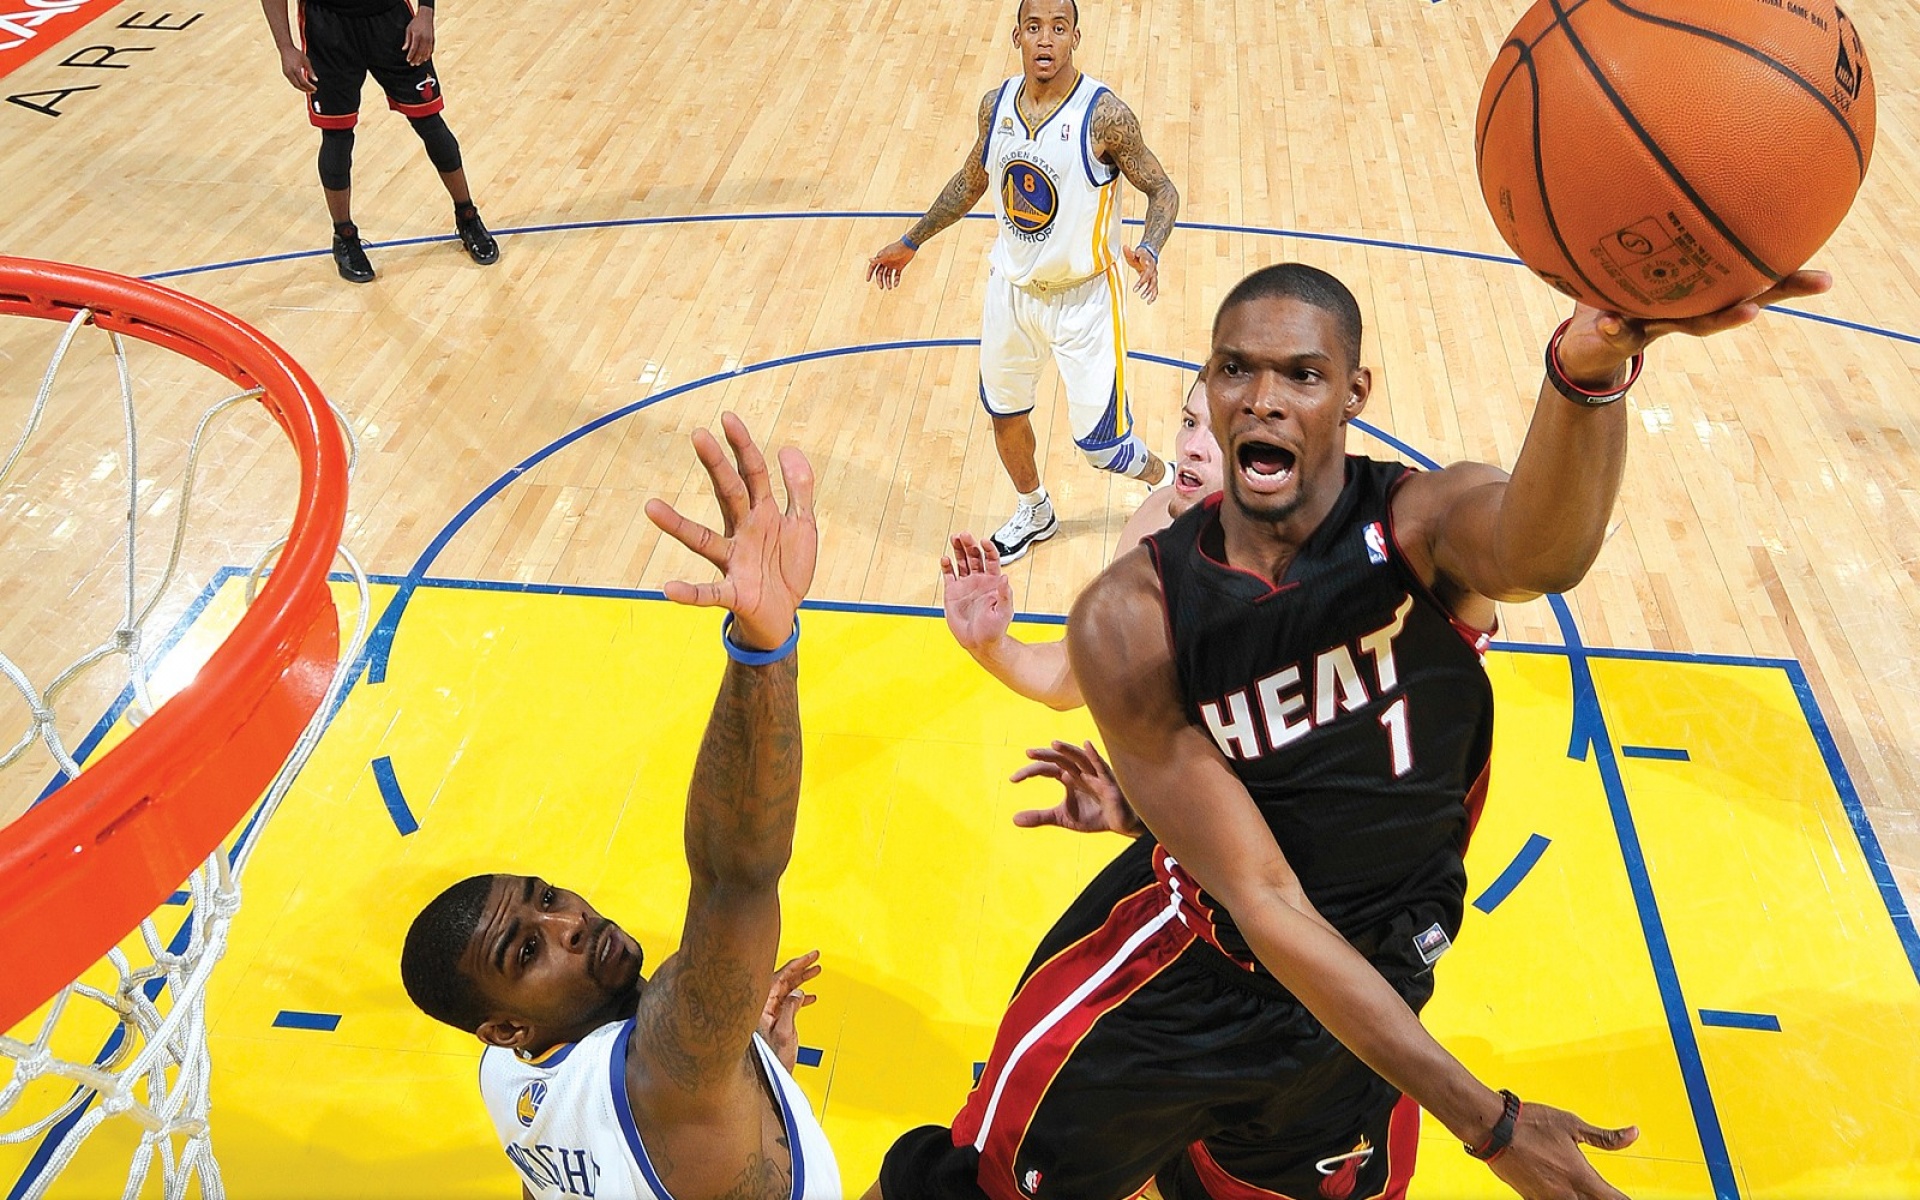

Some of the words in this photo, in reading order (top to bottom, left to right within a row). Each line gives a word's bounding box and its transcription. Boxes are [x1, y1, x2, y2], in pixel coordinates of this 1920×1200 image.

[5, 11, 205, 118] ARE
[999, 151, 1030, 169] GOLDEN
[1032, 156, 1060, 182] STATE
[1023, 173, 1035, 193] 8
[1197, 593, 1415, 761] HEAT
[1378, 694, 1414, 780] 1
